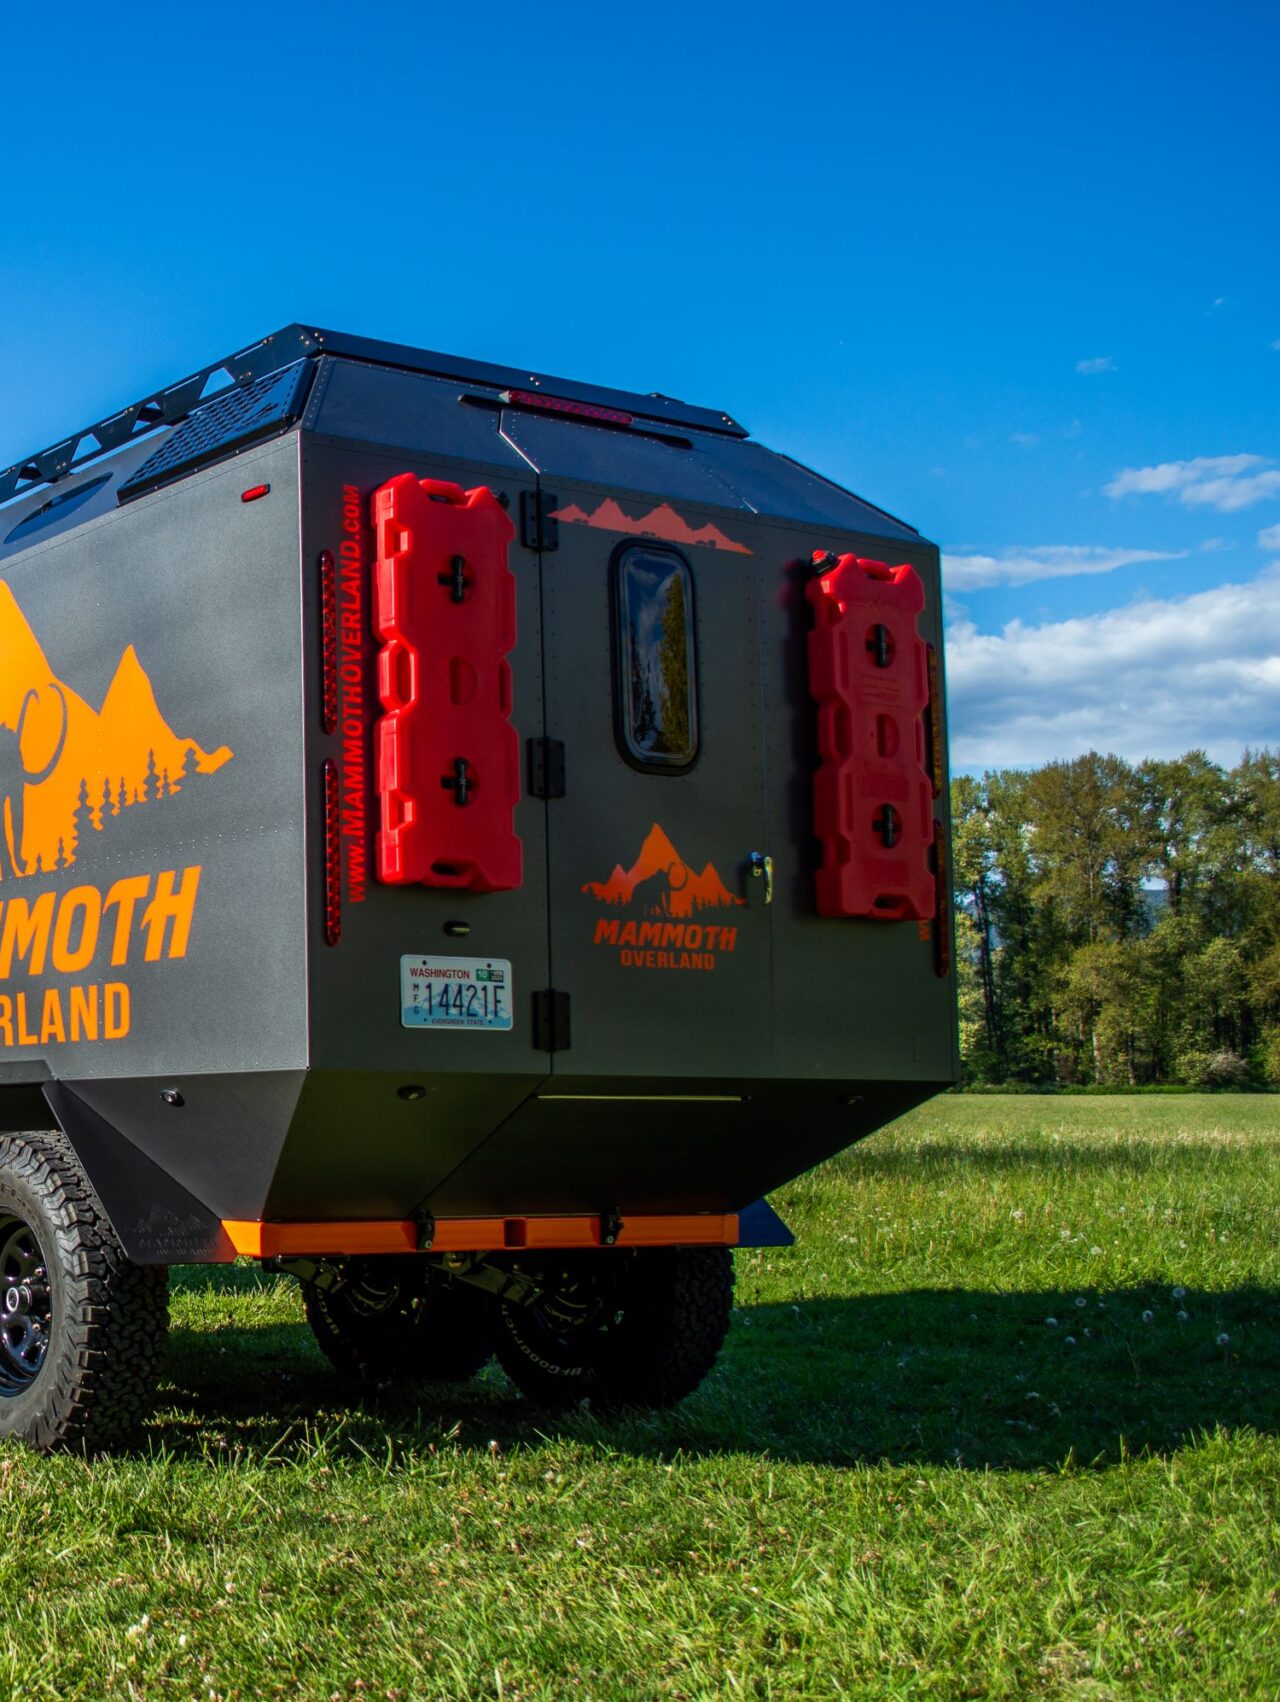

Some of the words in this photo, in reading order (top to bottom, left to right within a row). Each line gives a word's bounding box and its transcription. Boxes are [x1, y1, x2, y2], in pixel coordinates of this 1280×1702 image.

[593, 919, 738, 952] MAMMOTH
[410, 967, 471, 979] WASHINGTON
[620, 949, 715, 970] OVERLAND
[425, 982, 505, 1018] 14421F
